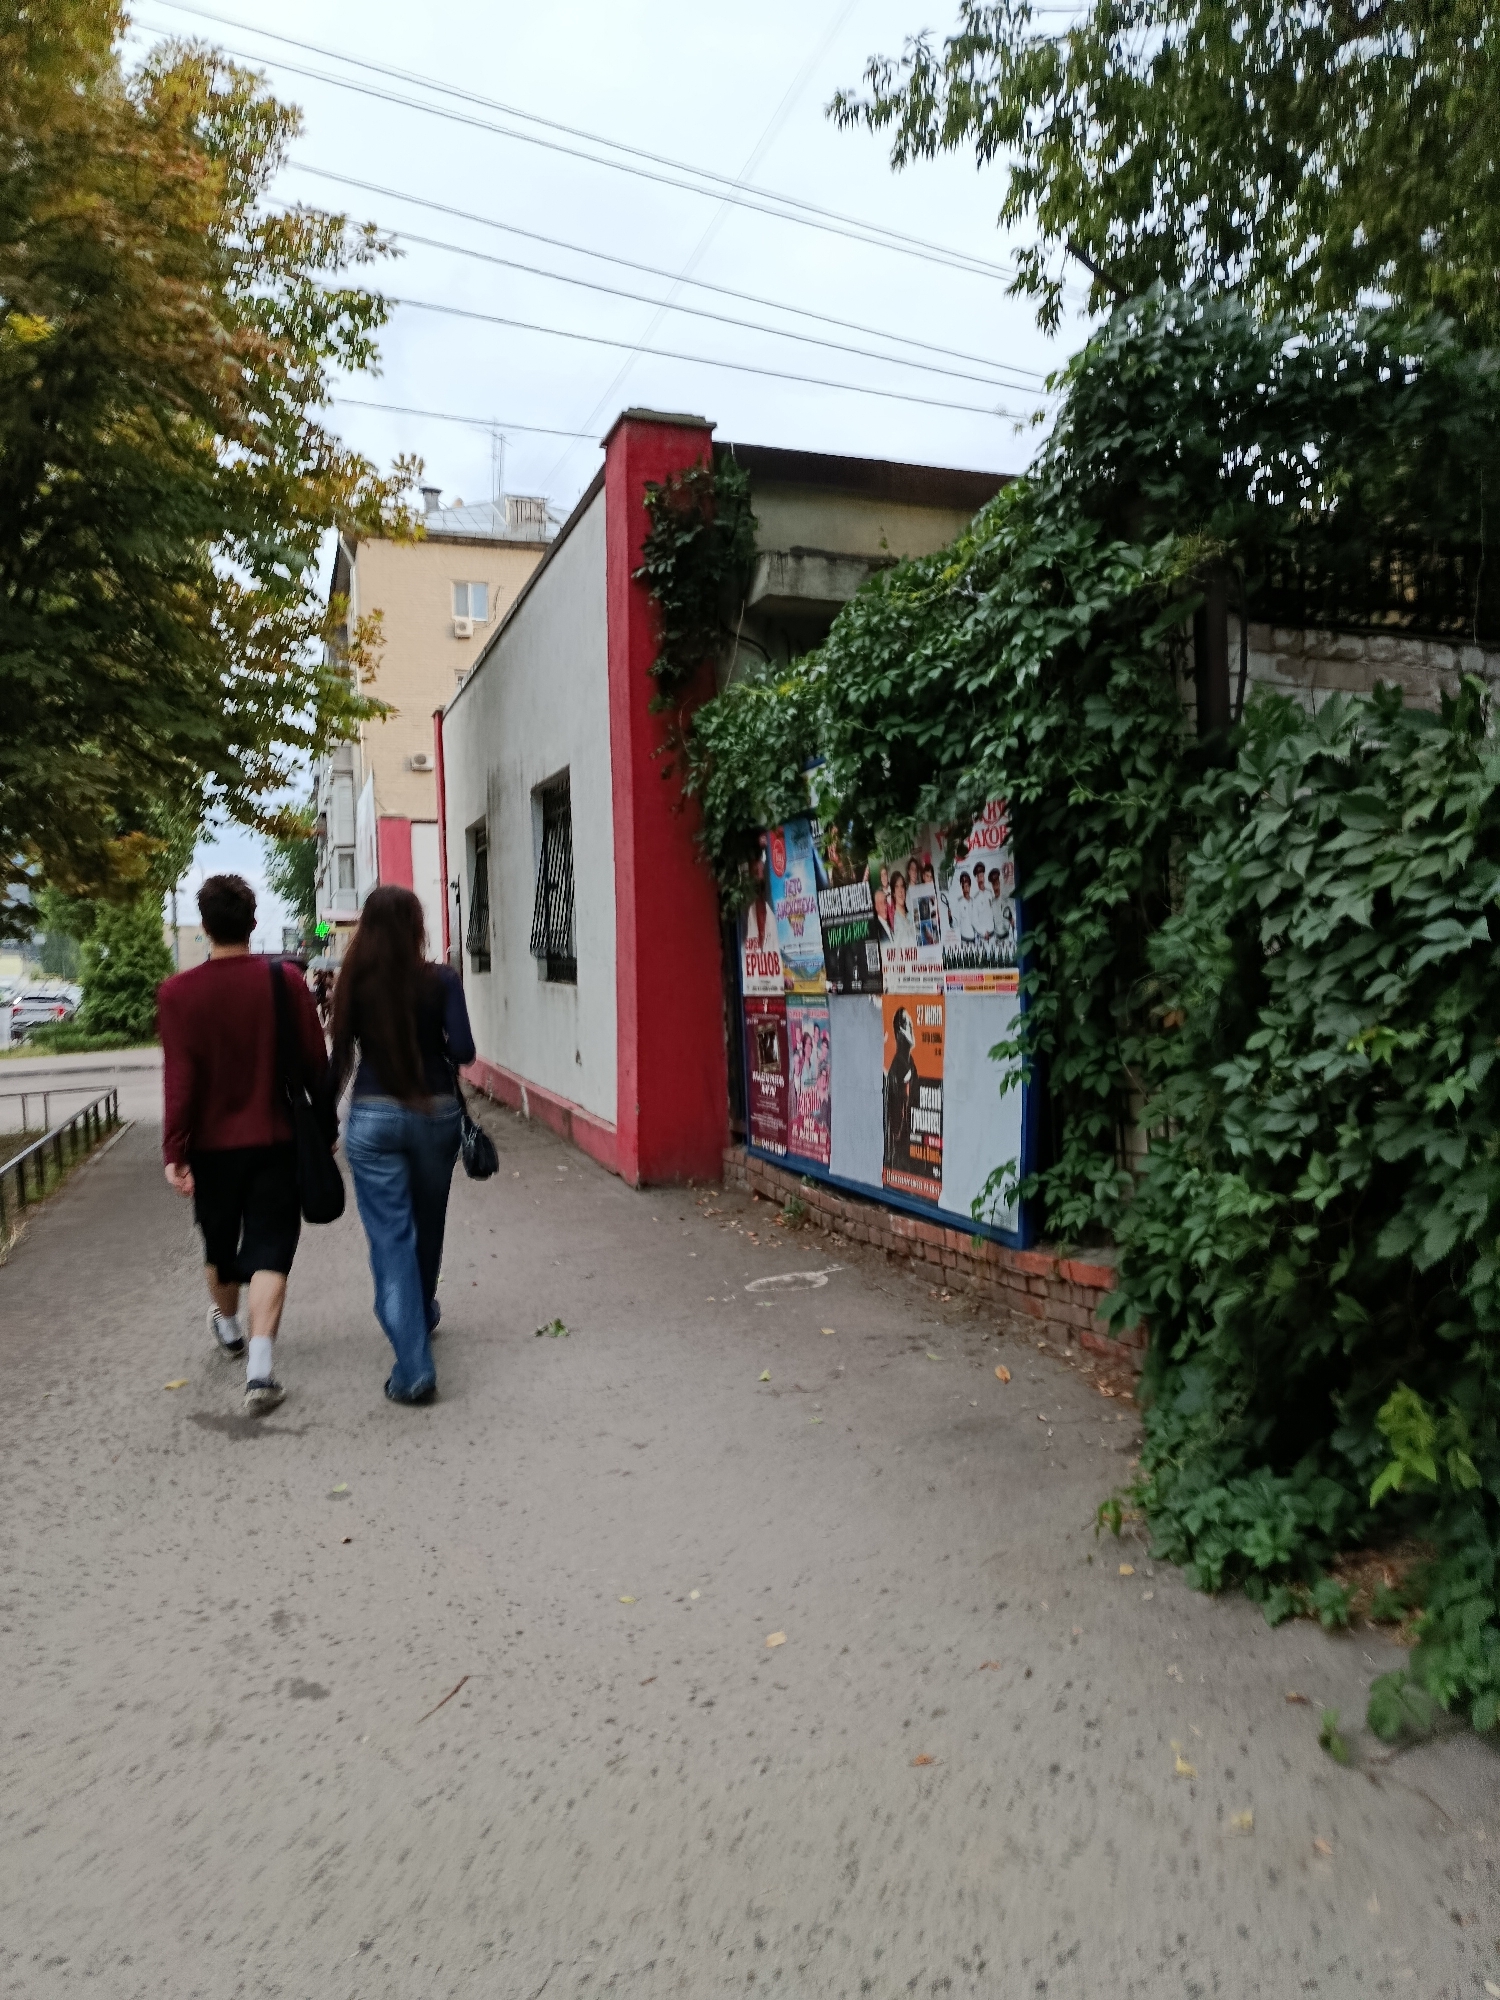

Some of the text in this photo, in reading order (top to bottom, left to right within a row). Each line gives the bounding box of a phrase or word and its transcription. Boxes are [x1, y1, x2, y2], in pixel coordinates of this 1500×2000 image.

[818, 887, 842, 919] MARCO
[839, 881, 873, 915] MENDOZA
[828, 927, 842, 950] VIVA
[746, 951, 781, 977] ЕРШОВ
[924, 1004, 943, 1027] ИЮНЯ
